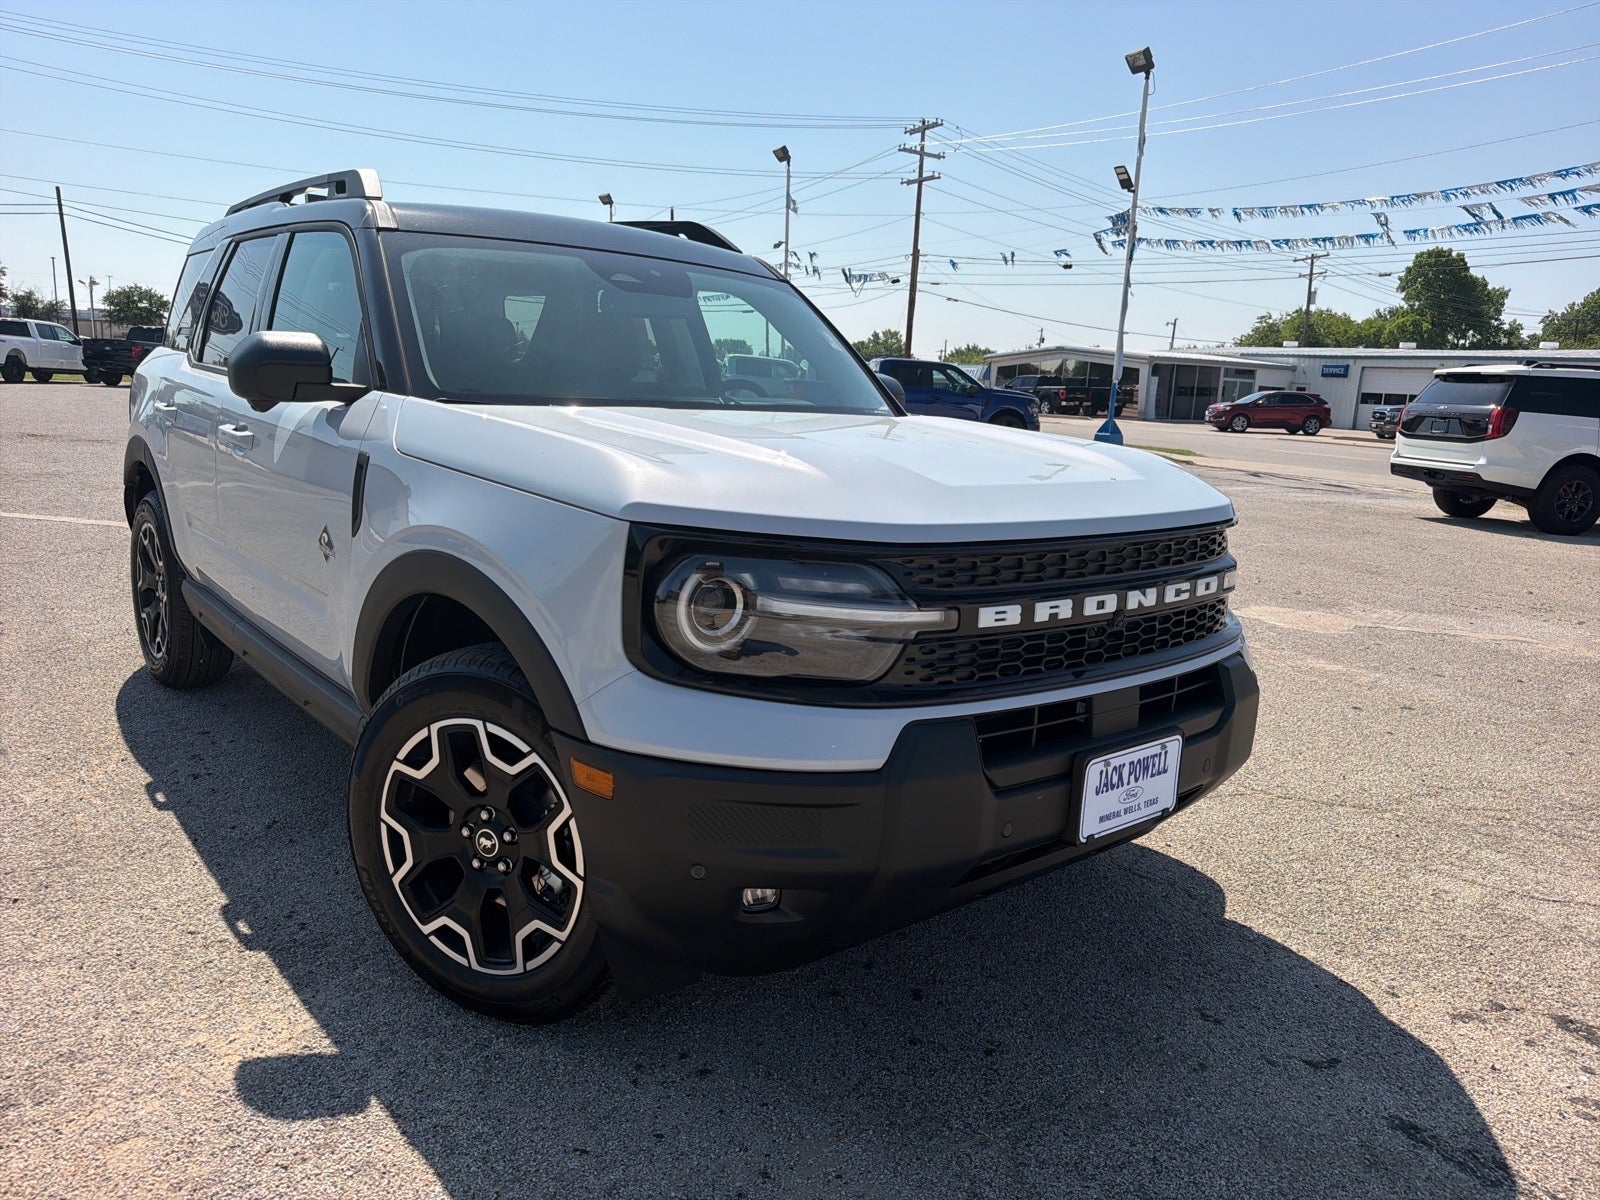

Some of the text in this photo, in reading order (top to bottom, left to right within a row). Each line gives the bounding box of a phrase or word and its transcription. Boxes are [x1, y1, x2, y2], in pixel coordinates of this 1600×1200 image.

[1322, 367, 1345, 375] SERVICE
[978, 576, 1218, 628] BRONCO
[1095, 750, 1169, 796] JACK POWELL
[1099, 810, 1122, 824] MINERAL
[1143, 796, 1159, 808] TEXAS
